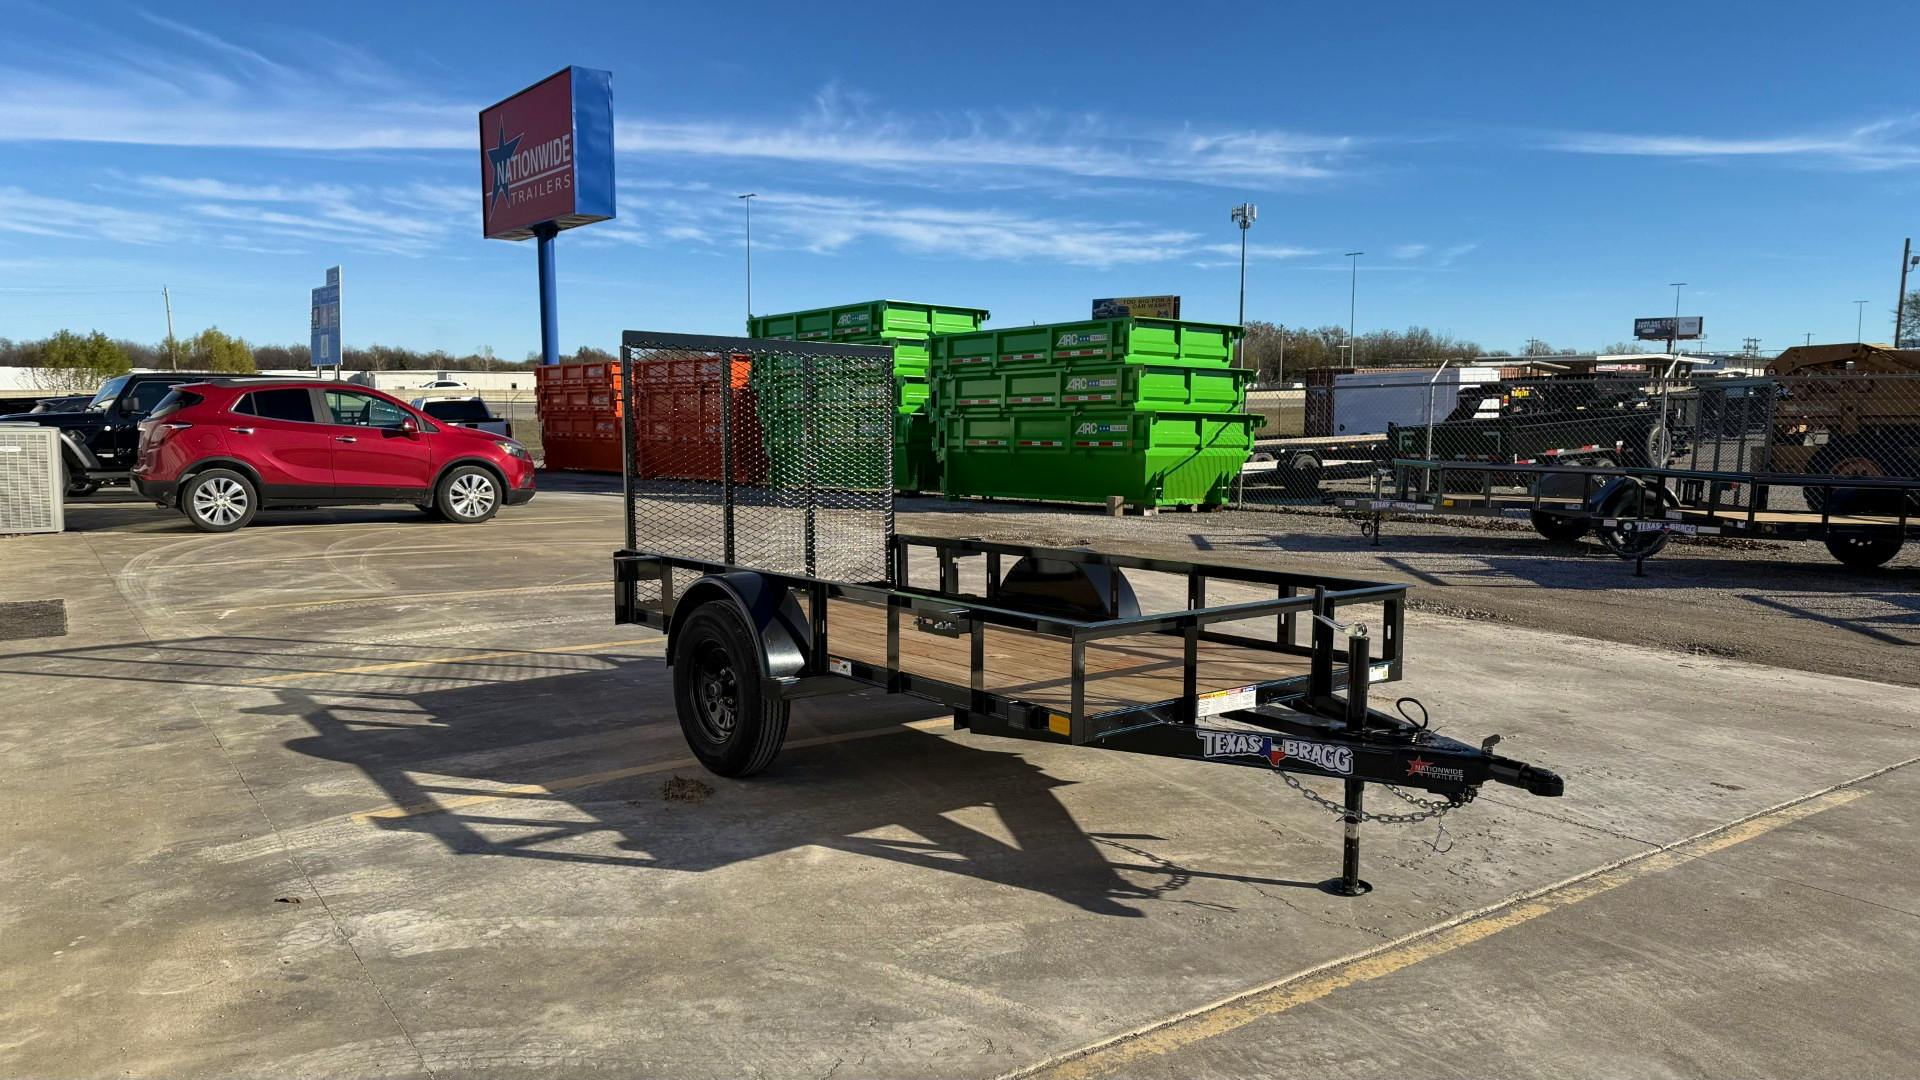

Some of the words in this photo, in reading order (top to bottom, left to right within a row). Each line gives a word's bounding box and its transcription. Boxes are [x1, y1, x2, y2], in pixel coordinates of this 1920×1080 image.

[496, 134, 571, 186] NATIONWIDE
[511, 174, 571, 206] TRAILERS
[1056, 333, 1078, 346] ARC
[1065, 378, 1087, 390] ARC
[1075, 422, 1098, 435] ARC
[1635, 521, 1662, 532] TEXAS
[1668, 522, 1697, 535] BRAGG
[1197, 731, 1263, 757] TEXAS
[1284, 739, 1354, 774] BRAGG
[1415, 764, 1464, 776] NATIONWIDE
[1427, 773, 1463, 781] TRAILERS
